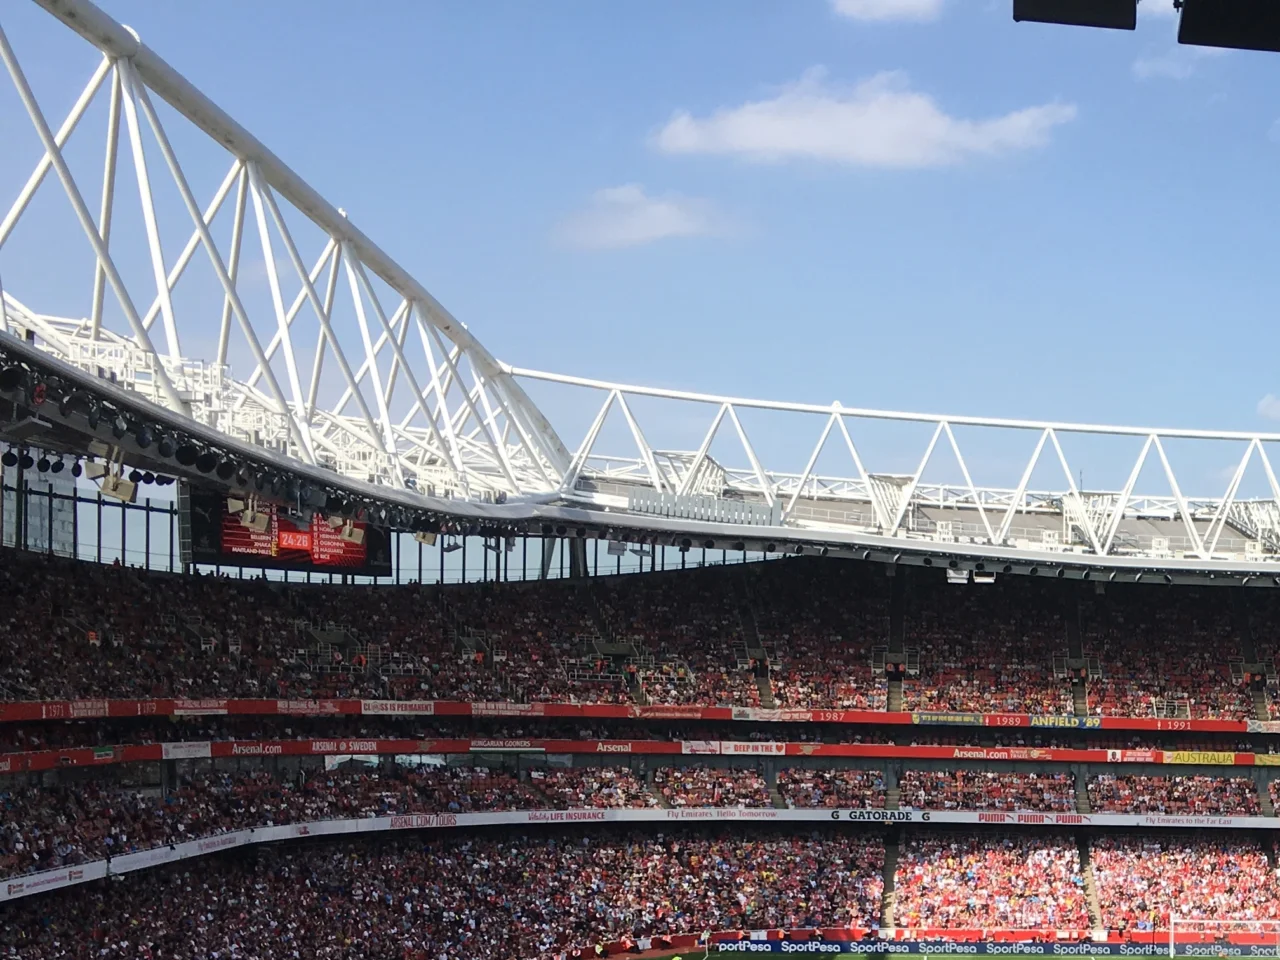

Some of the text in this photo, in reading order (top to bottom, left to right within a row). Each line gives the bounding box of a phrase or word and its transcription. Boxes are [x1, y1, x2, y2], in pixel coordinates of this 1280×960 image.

[282, 534, 308, 547] 24:26
[49, 704, 64, 717] 1971
[389, 703, 396, 712] IS
[396, 702, 432, 713] PERMANENT
[820, 712, 844, 721] 1987
[996, 717, 1020, 726] 1989
[1030, 718, 1100, 728] ANFIELD '89
[1167, 722, 1192, 730] 1991
[232, 744, 282, 754] Arsenal.com
[312, 742, 336, 751] ARSENAL
[348, 742, 376, 750] SWEDEN
[596, 742, 632, 752] Arsenal
[734, 744, 773, 752] DEEP IN THE
[953, 748, 1008, 759] Arsenal.com
[1174, 752, 1233, 763] AUSTRALIA
[550, 812, 564, 820] LIFE
[566, 812, 605, 820] INSURANCE
[667, 810, 678, 819] Fly
[831, 810, 930, 821] G GATORADE G
[978, 813, 1006, 822] PUMA
[1018, 814, 1044, 824] PUMA
[1056, 814, 1082, 824] PUMA
[1146, 817, 1156, 825] Fly
[718, 940, 772, 952] portPesa
[781, 941, 840, 953] SportPesa
[850, 942, 910, 954] SportPesa
[918, 942, 977, 954] SportPesa
[986, 944, 1044, 955] SportPesa
[1053, 944, 1110, 956] SportPesa
[1185, 945, 1242, 956] SportPesa
